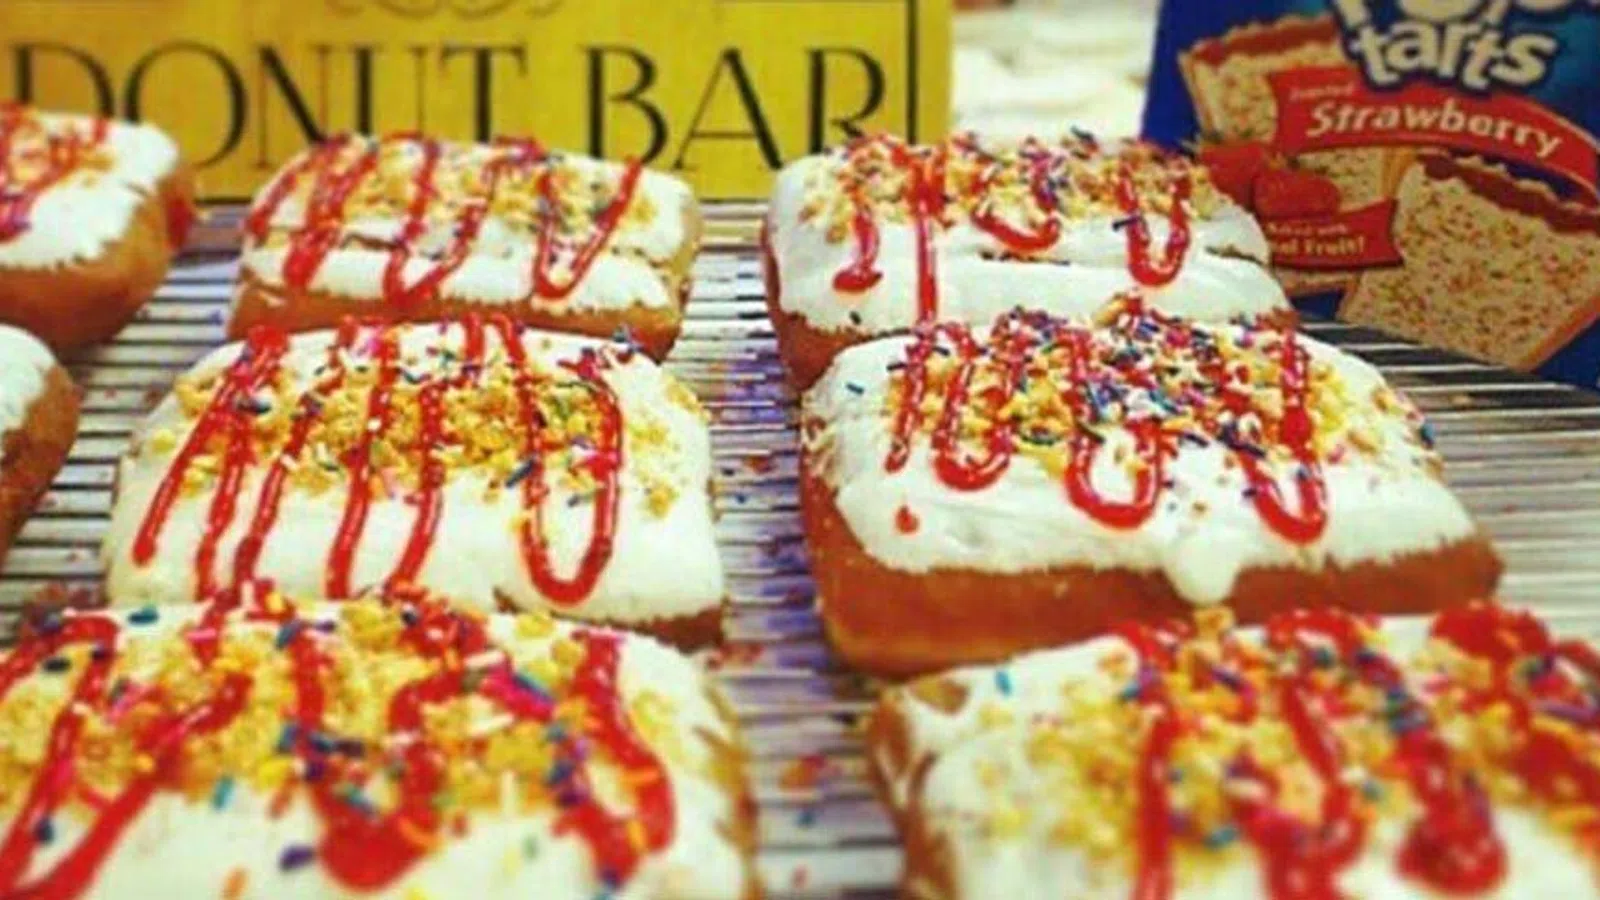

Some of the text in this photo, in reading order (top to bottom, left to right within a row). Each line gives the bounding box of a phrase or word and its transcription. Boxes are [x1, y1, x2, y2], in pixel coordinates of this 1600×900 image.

[1351, 21, 1557, 91] tarts
[10, 40, 888, 170] DONUT BAR
[1305, 98, 1563, 159] Strawberry
